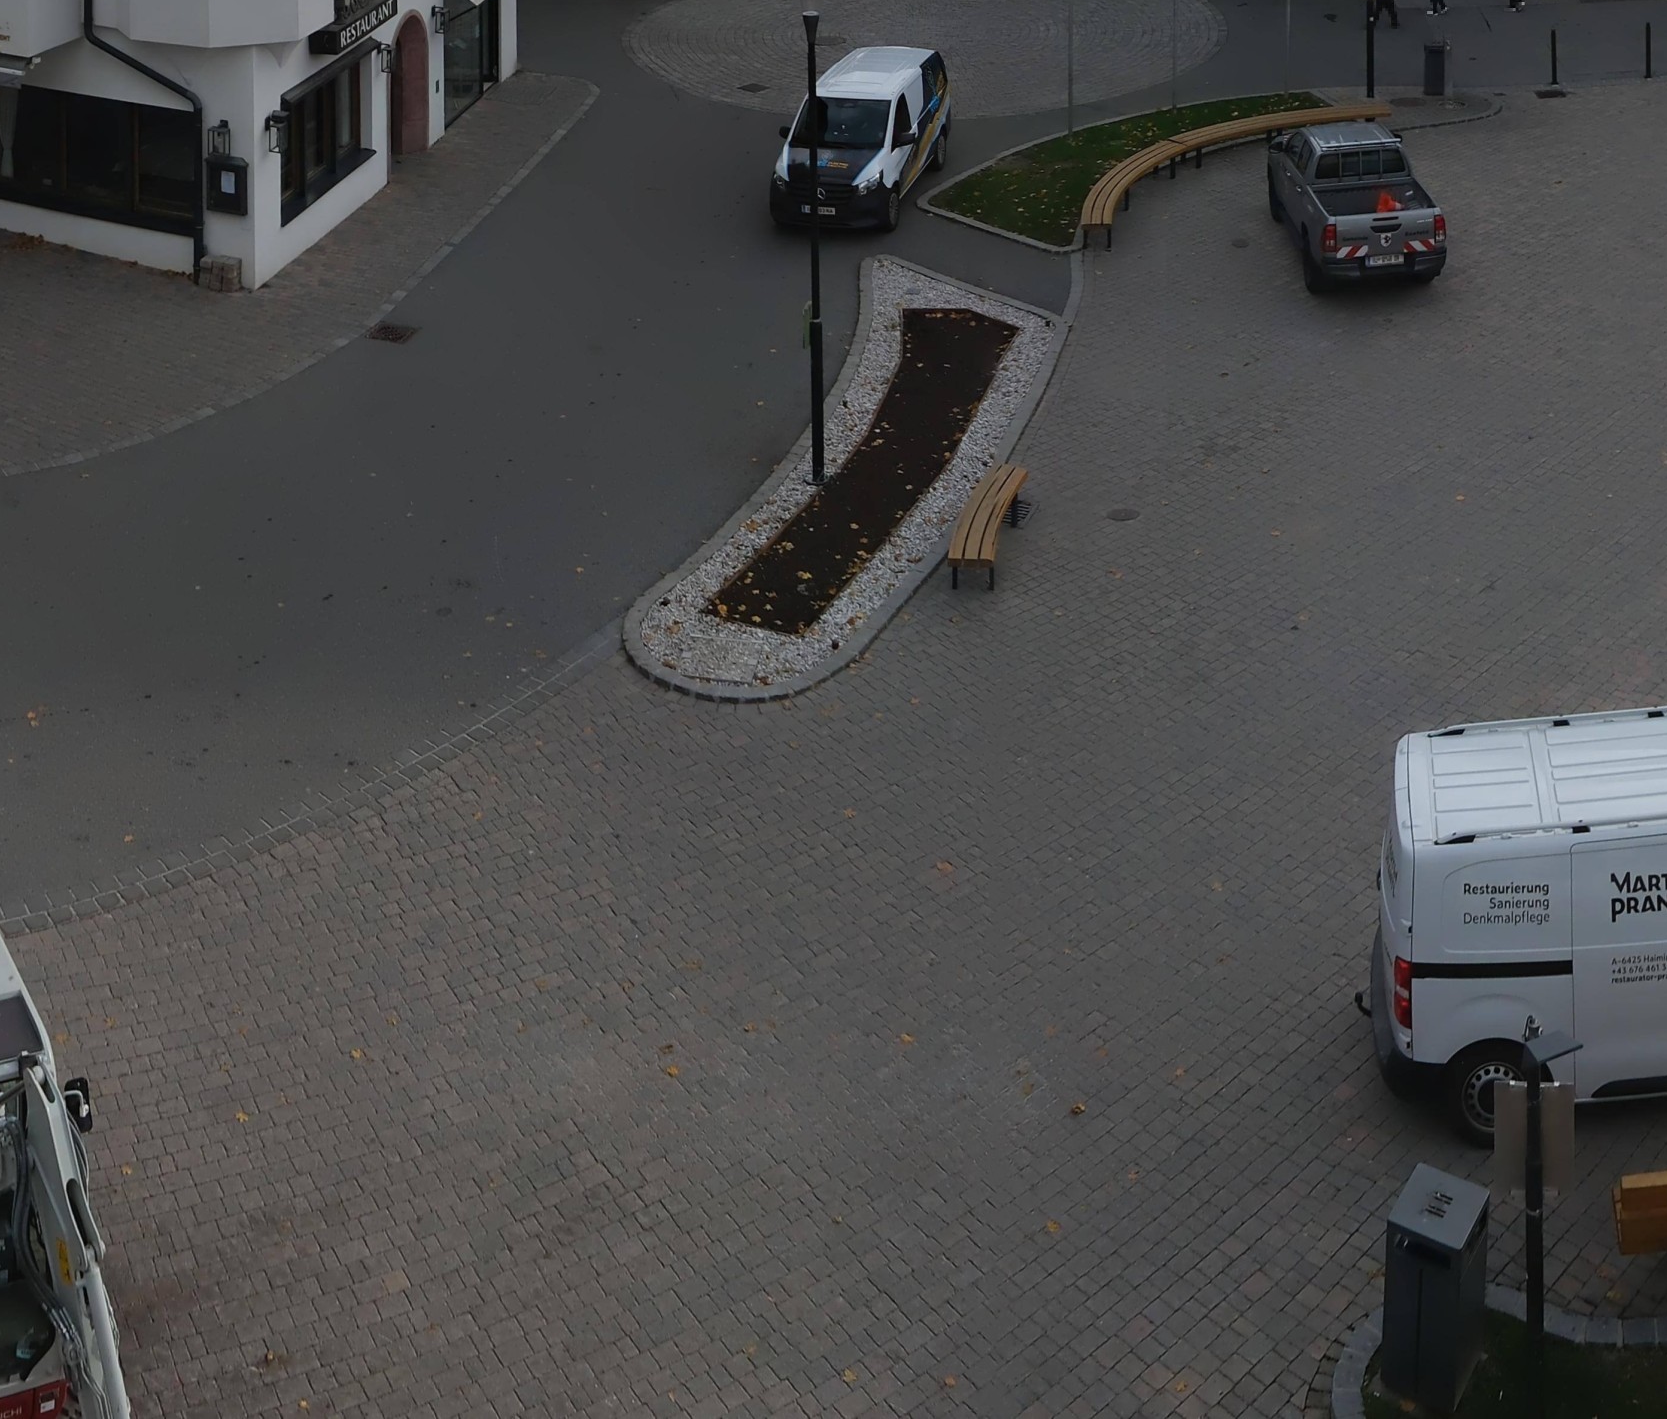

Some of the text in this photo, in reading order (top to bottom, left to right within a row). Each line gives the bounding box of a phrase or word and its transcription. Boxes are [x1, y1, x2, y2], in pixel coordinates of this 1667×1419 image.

[1463, 882, 1550, 897] Restaurierung
[1489, 897, 1550, 910] Sanierung
[1463, 911, 1550, 925] Denkmalpflege
[1611, 955, 1642, 966] A-6425
[1612, 965, 1627, 975] +43
[1629, 964, 1646, 974] 676
[1648, 963, 1660, 973] 461
